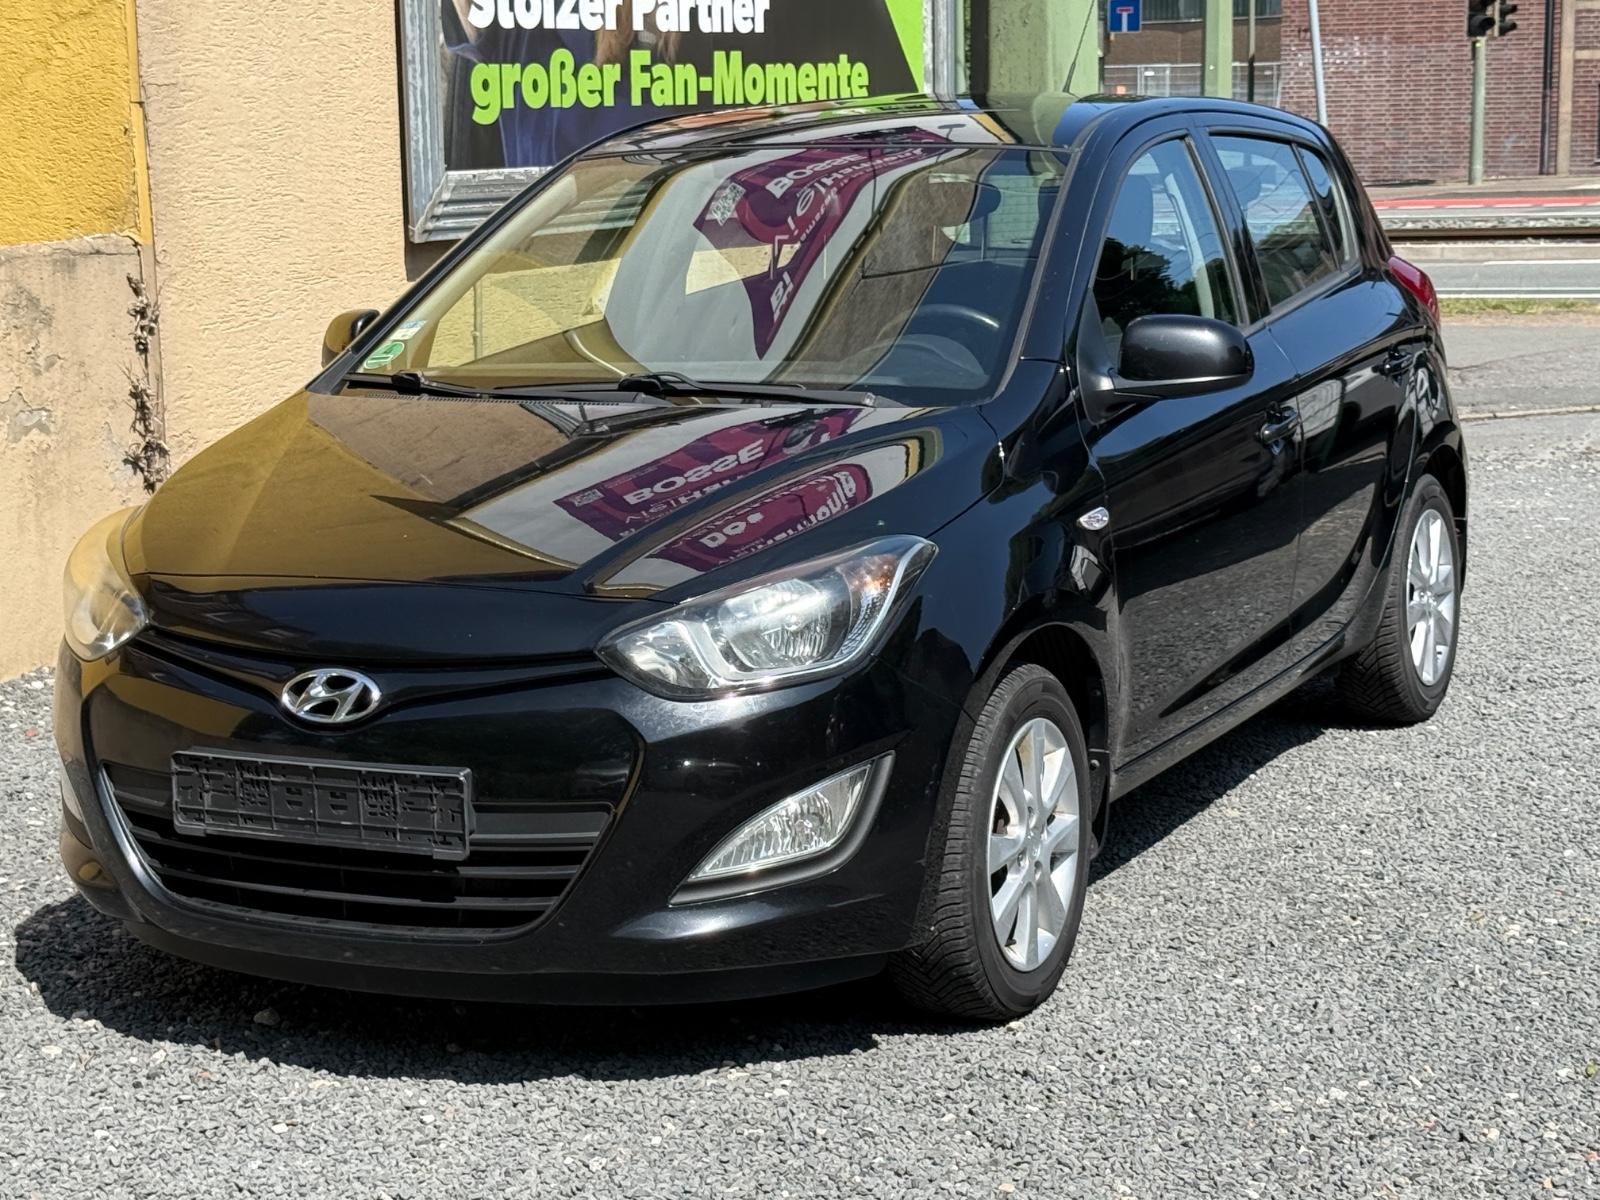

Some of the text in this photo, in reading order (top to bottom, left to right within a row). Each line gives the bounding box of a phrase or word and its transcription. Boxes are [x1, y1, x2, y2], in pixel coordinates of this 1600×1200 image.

[467, 0, 770, 33] Stolzer Partner
[470, 48, 869, 125] großer Fan-Momente
